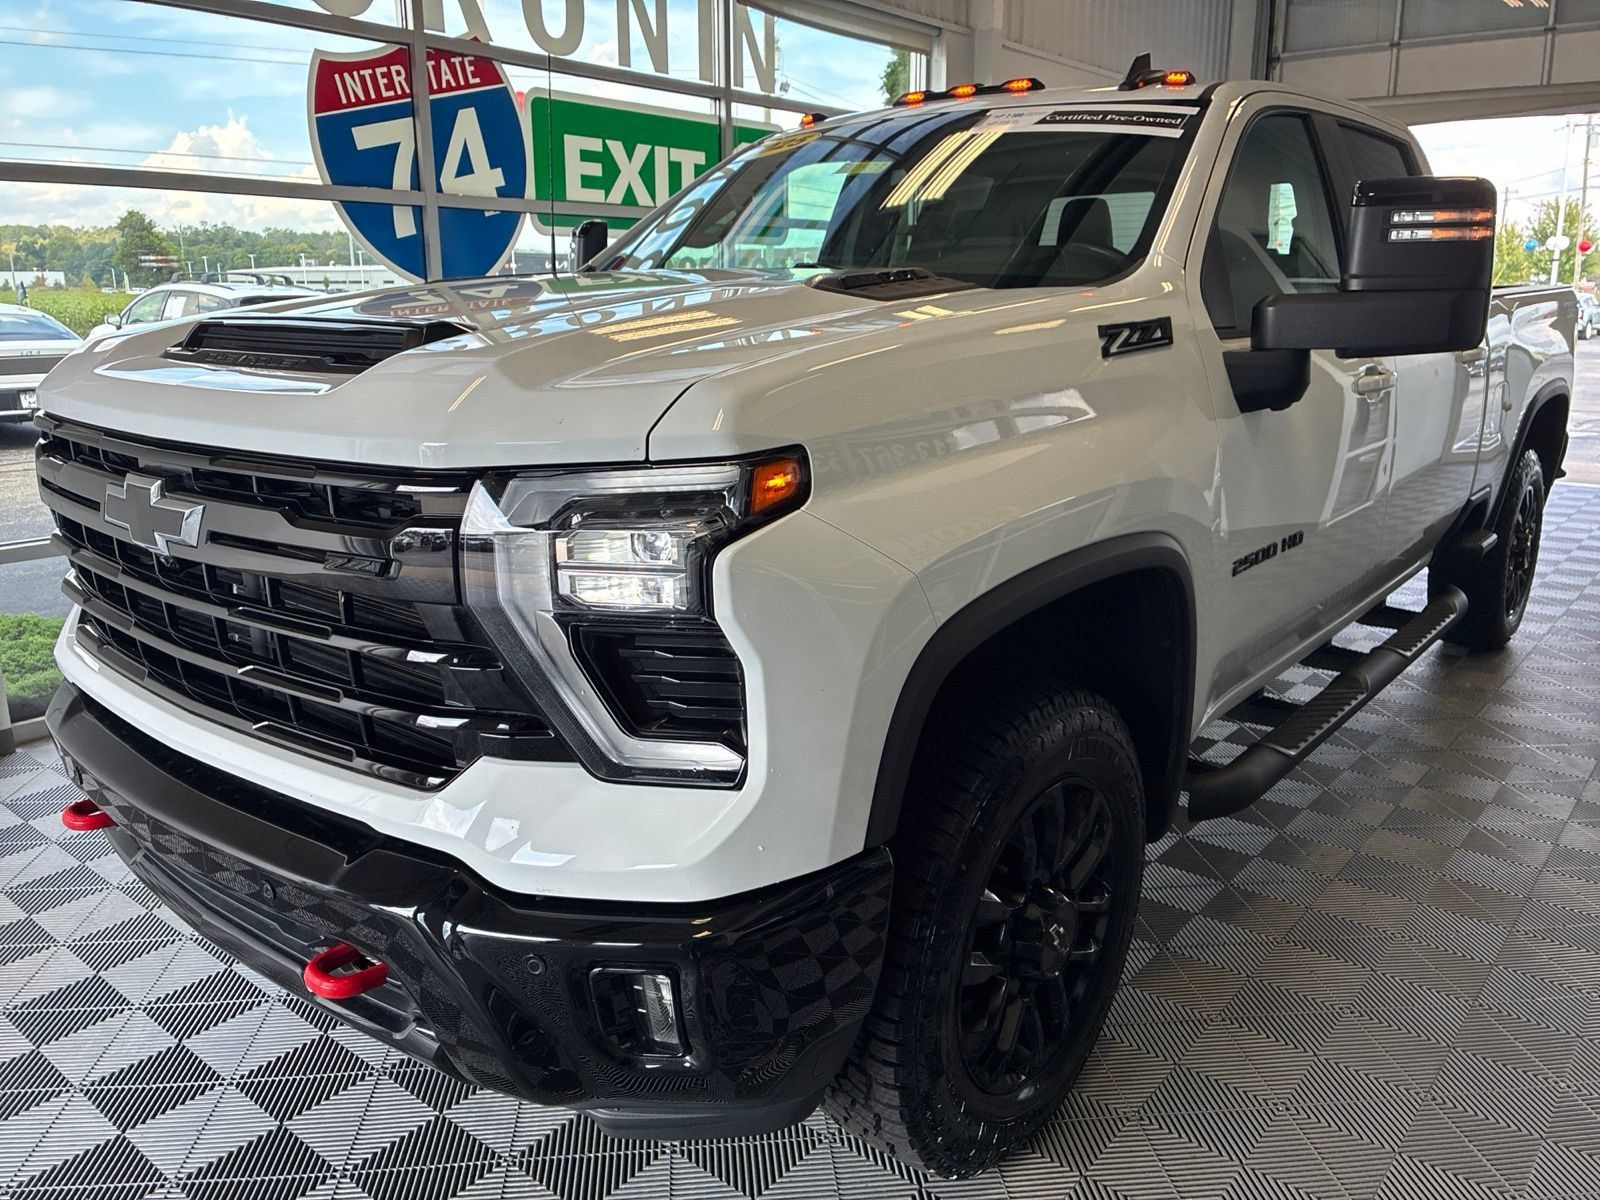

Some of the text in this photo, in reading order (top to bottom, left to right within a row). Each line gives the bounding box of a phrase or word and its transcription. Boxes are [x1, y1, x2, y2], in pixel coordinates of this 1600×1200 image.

[333, 56, 481, 104] INTERTATE
[1045, 112, 1103, 122] Certified
[1105, 113, 1182, 125] Pre-Owned
[351, 107, 506, 238] 74
[563, 134, 706, 207] EXIT
[1232, 529, 1304, 577] 2500 HD
